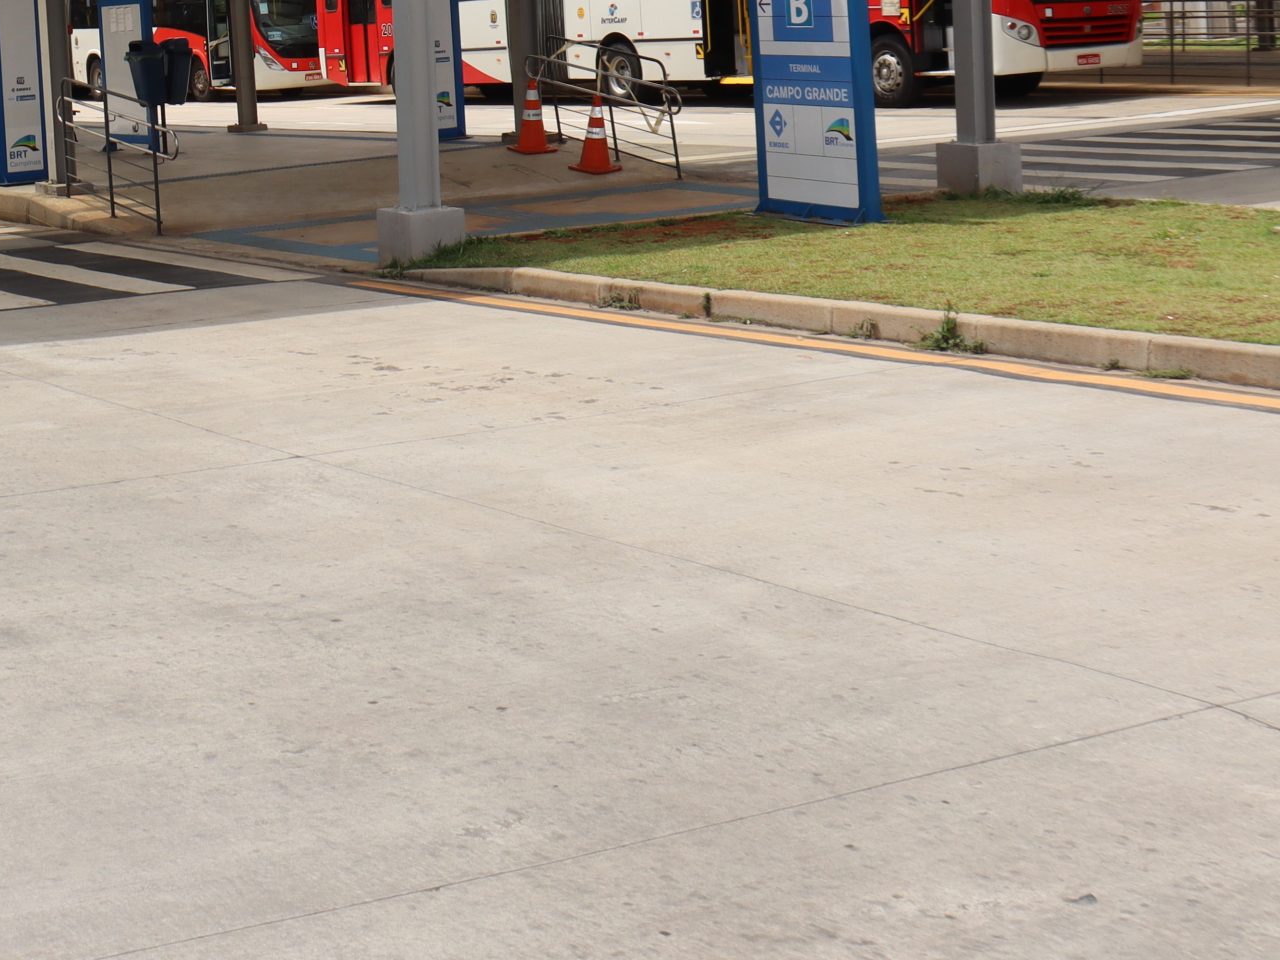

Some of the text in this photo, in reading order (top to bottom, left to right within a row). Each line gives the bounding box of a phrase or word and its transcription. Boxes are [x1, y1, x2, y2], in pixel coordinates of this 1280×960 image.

[789, 63, 822, 74] TERMINAL
[766, 85, 849, 102] CAMPO GRANDE
[825, 136, 839, 146] BRT
[9, 149, 29, 160] BRT
